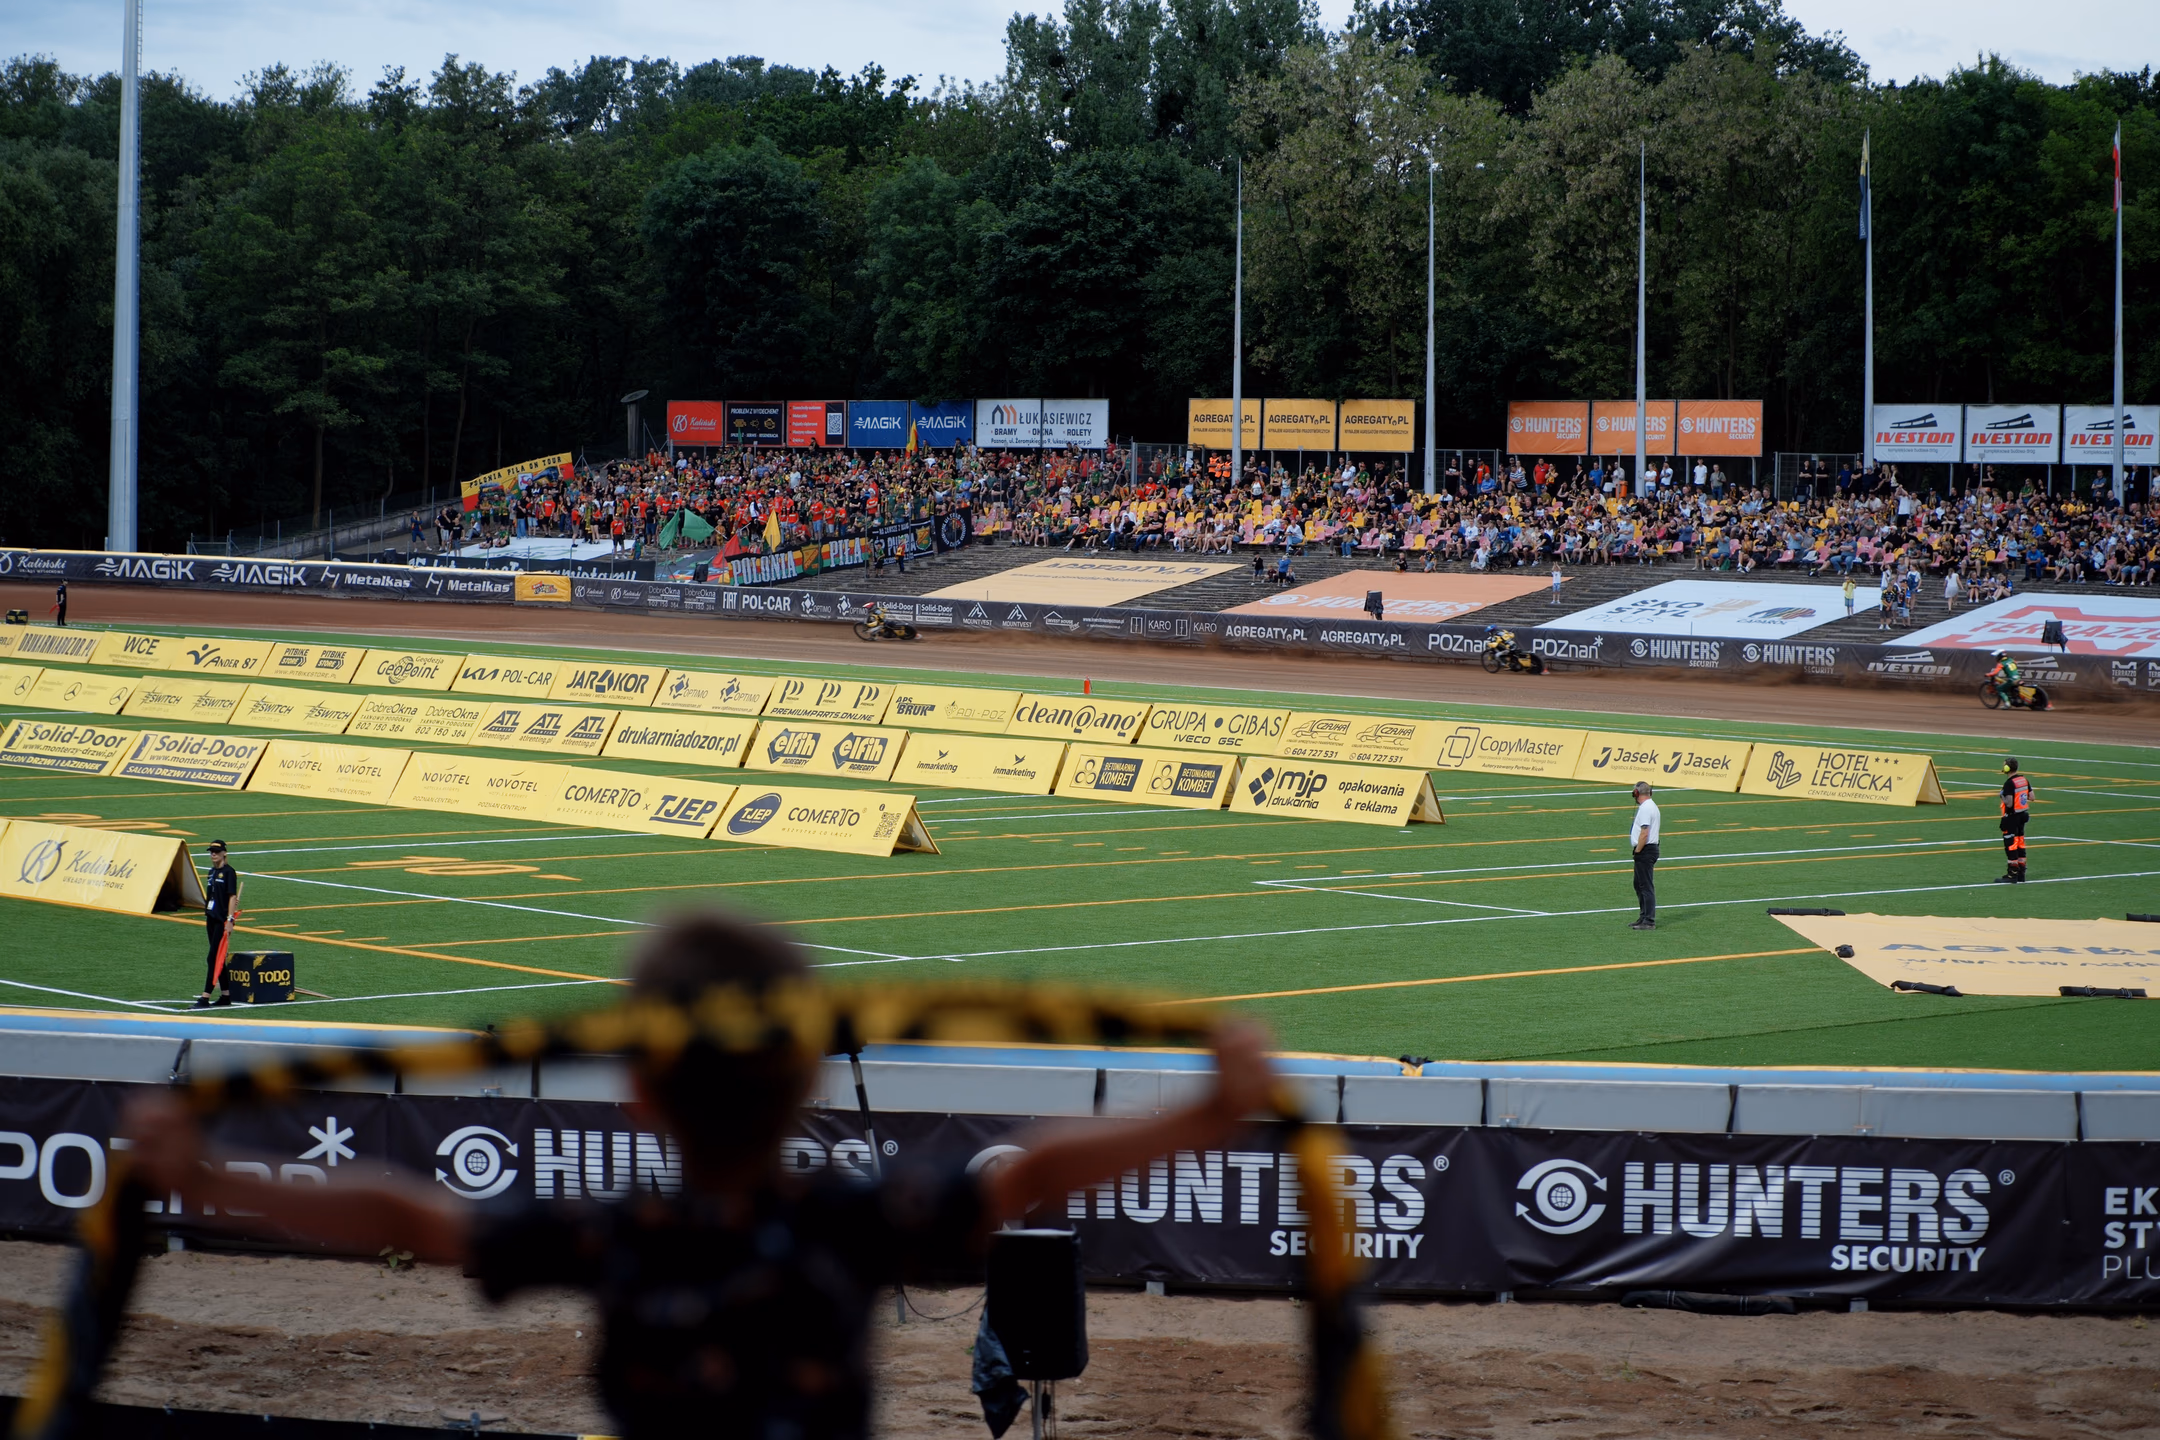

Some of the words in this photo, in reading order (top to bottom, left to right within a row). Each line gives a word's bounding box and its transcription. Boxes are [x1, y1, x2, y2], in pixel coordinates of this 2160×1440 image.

[861, 416, 901, 429] MAGIK
[923, 415, 966, 429] MAGIK
[1525, 417, 1582, 433] HUNTERS
[1612, 416, 1667, 432] HUNERS
[1696, 417, 1756, 433] HUNTERS
[994, 428, 1017, 436] BRAMY
[1067, 428, 1092, 436] ROLETY
[107, 559, 194, 580] MAGIK
[222, 563, 307, 587] MAGIK
[731, 550, 798, 587] POLONIA
[344, 573, 411, 588] Metalkas
[447, 580, 511, 594] Metalkas
[742, 594, 791, 612] POL-CAR
[1002, 620, 1033, 628] MOUNTVEST
[1148, 620, 1171, 631] KARO
[1193, 622, 1217, 633] KARO
[123, 636, 160, 656] WCE
[284, 648, 310, 657] PITBIKE
[1650, 640, 1720, 660] HUNTERS
[320, 650, 347, 659] PITBIKE
[1763, 643, 1836, 667] HUNTERS
[241, 657, 258, 670] 87
[377, 659, 440, 679] GeoPoint
[1689, 659, 1719, 668] SECURITY
[501, 669, 553, 687] POL-CAR
[149, 694, 183, 706] SWITCH
[683, 688, 709, 699] OPTIMO
[733, 692, 760, 703] OPTIMO
[201, 698, 236, 709] SWITCH
[259, 702, 295, 715] SWITCH
[365, 701, 418, 716] DobreOkna
[897, 703, 928, 717] BRUK
[425, 705, 479, 721] DobreOkna
[770, 707, 875, 722] PREMIUMPARTS.ONLINE
[355, 722, 370, 731] 602
[372, 723, 387, 732] 150
[1150, 708, 1207, 732] GRUPA
[1228, 713, 1283, 738] GIBAS
[28, 723, 127, 749] Solid-Door
[415, 726, 429, 735] 602
[433, 728, 449, 737] 150
[451, 730, 467, 738] 364
[154, 735, 258, 760] Solid-Door
[617, 726, 742, 755] drukarniadozor.pl
[1174, 735, 1211, 745] IVECO
[1218, 737, 1244, 747] GSC
[1480, 736, 1564, 757] CopyMaster
[22, 743, 117, 760] www.monterzy-drzwi.pl
[1291, 747, 1307, 756] 604
[1308, 749, 1323, 758] 727
[1323, 751, 1339, 759] 531
[1356, 753, 1372, 762] 604
[1373, 754, 1388, 763] 727
[1388, 756, 1403, 764] 531
[1613, 748, 1660, 765] Jasek
[1, 754, 26, 764] SALON
[26, 755, 54, 766] DRZWI
[150, 753, 249, 771] www.monterzy-drzwi.pl
[279, 759, 322, 772] NOVOTEL
[917, 761, 958, 773] inmarketing
[1684, 752, 1732, 770] Jasek
[1817, 752, 1870, 772] HOTEL
[127, 766, 154, 776] SALON
[154, 767, 185, 779] DRZWI
[336, 764, 382, 777] NOVOTEL
[993, 766, 1037, 780] inmarketing
[422, 772, 470, 785] NOVOTEL
[487, 777, 538, 792] NOVOTEL
[1099, 772, 1135, 787] KOMBET
[1176, 777, 1214, 793] KOMBET
[1277, 770, 1328, 799] mjp
[1811, 770, 1894, 793] LECHICKA
[1338, 780, 1405, 797] opakowania
[1807, 789, 1836, 797] CENTRUM
[654, 795, 718, 821] TJEP
[1271, 796, 1319, 809] drukarnia
[1344, 798, 1352, 810] &
[1355, 799, 1398, 815] reklama
[741, 807, 773, 821] TJEP
[229, 969, 250, 983] TODO
[258, 969, 291, 984] TODO
[1623, 1162, 1992, 1242] HUNTERS
[1831, 1245, 1987, 1273] SECURITY
